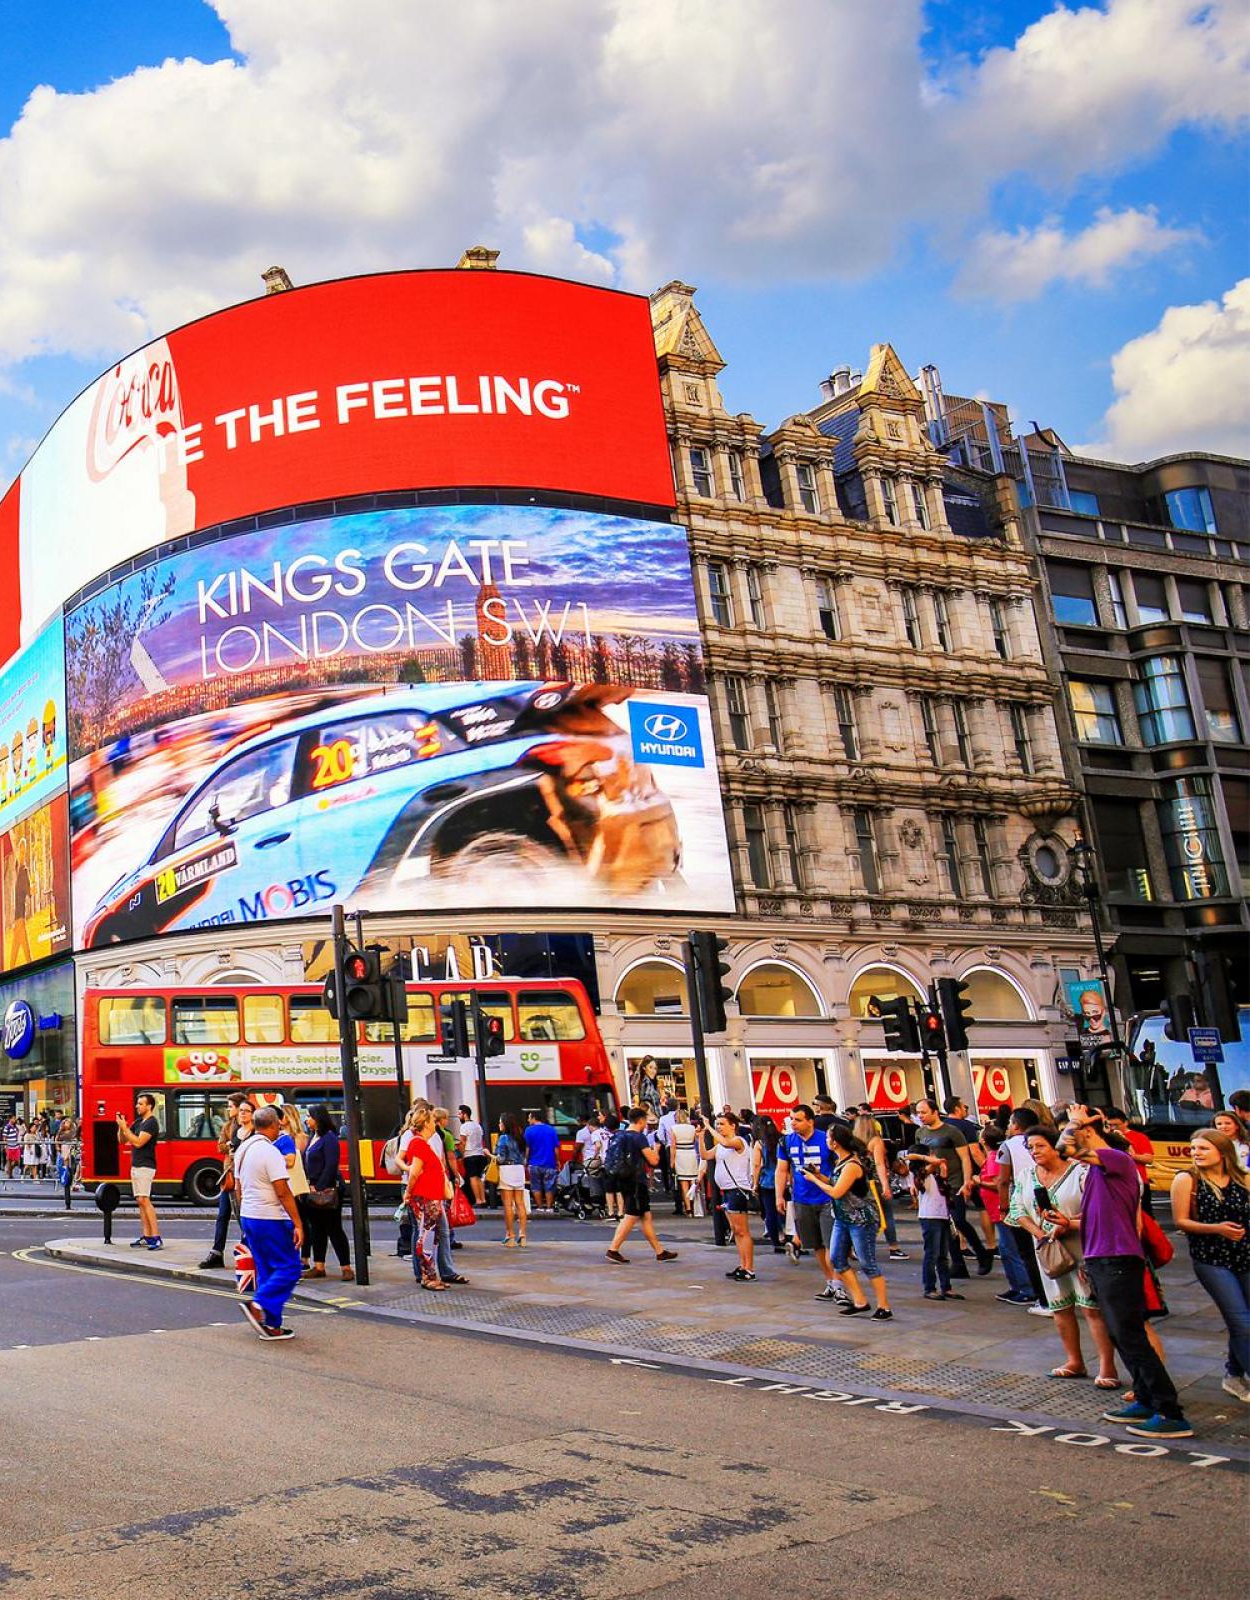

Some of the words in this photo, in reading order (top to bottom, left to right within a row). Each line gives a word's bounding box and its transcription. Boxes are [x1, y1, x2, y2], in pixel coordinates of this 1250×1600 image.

[214, 390, 321, 450] THE
[197, 547, 367, 625] KINGS
[383, 538, 532, 593] GATE
[201, 598, 457, 680] LONDON
[481, 597, 593, 649] SW1
[309, 738, 353, 790] 20
[640, 742, 696, 759] HYUNDAI
[156, 868, 178, 902] 20
[239, 869, 338, 922] MOBIS
[249, 1054, 294, 1064] Fresher.
[296, 1053, 341, 1064] Sweeter.
[251, 1065, 276, 1075] With
[278, 1065, 322, 1076] Hotpoint
[325, 1065, 343, 1075] Act
[752, 1065, 799, 1104] 70
[865, 1065, 908, 1104] 70
[970, 1064, 1011, 1102] 70
[708, 1376, 931, 1415] RIGHT
[989, 1419, 1231, 1467] LOOK
